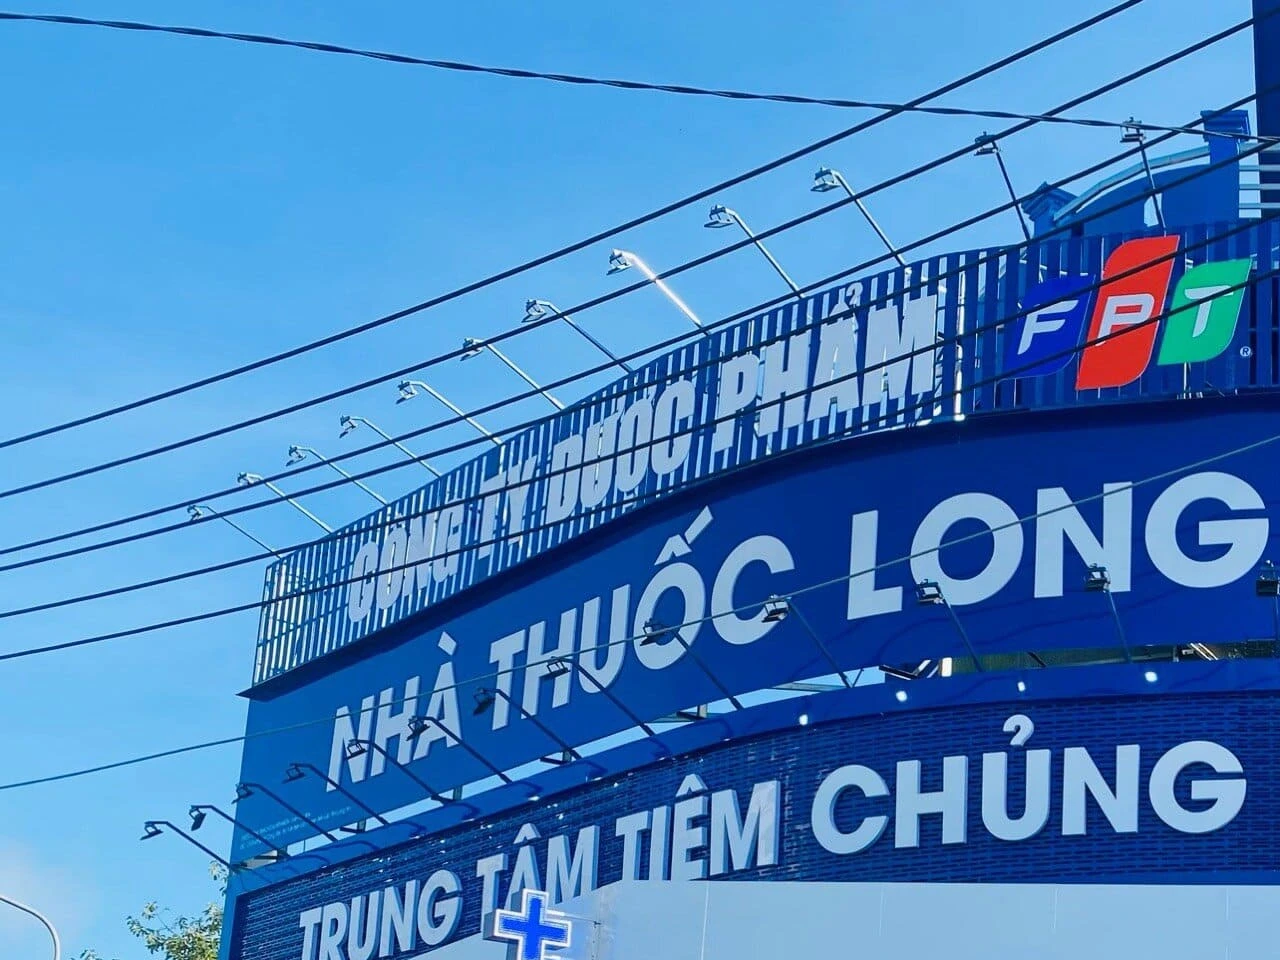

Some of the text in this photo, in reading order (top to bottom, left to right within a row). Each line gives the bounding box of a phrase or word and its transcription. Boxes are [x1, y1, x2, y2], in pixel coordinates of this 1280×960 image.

[326, 631, 461, 791] NHÀ
[490, 508, 795, 731] THUỐC
[848, 471, 1270, 620] LONG
[477, 823, 600, 932] TÂM
[615, 775, 781, 884] TIÊM
[811, 714, 1247, 855] CHỦNG
